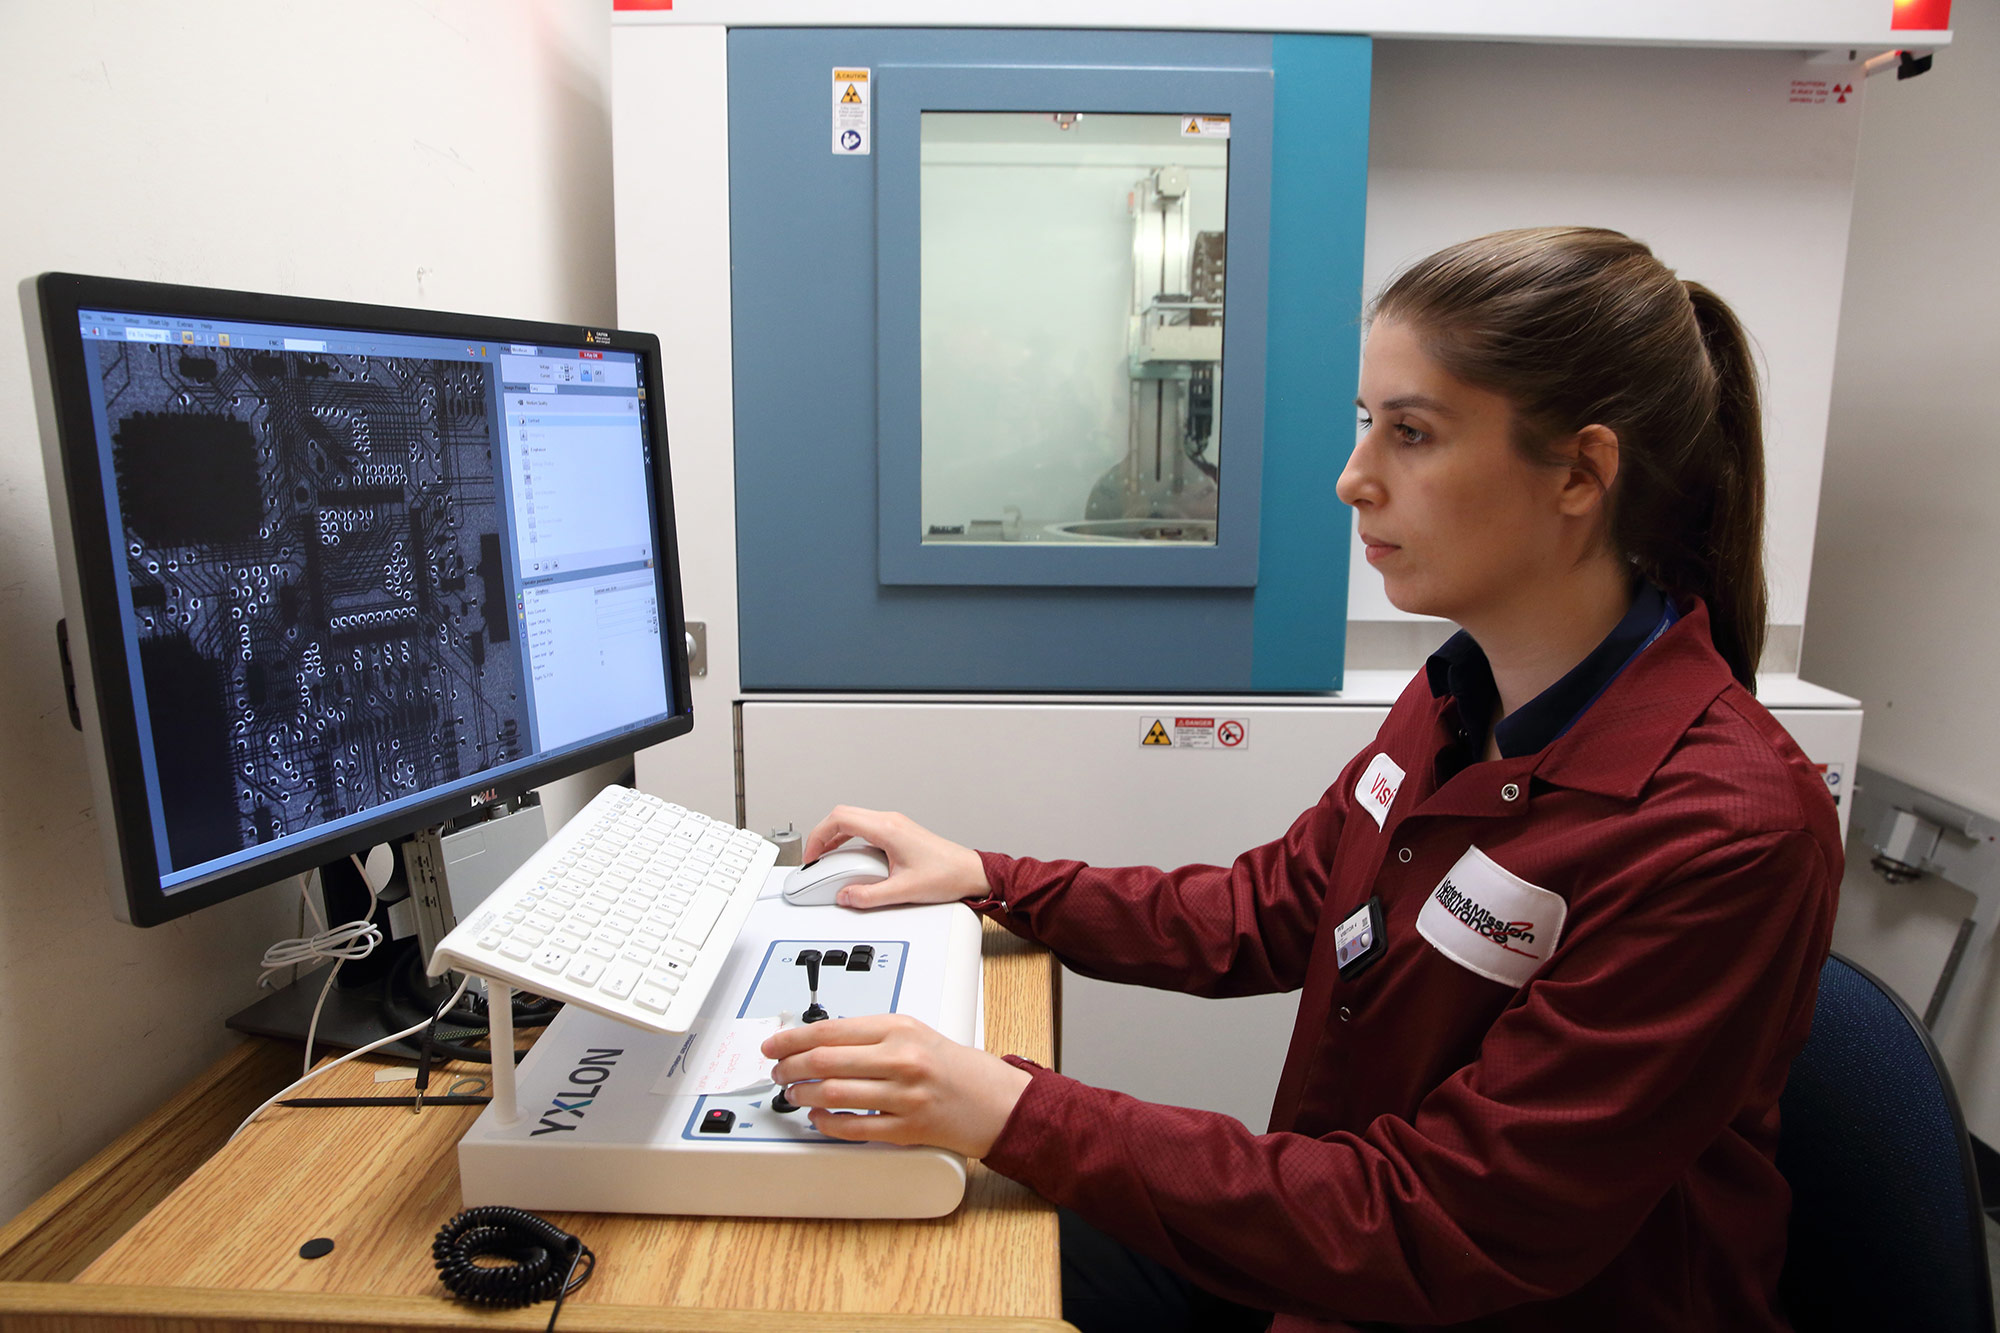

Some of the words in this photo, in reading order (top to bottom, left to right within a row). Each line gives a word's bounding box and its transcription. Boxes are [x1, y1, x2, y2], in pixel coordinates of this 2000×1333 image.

[471, 788, 498, 808] DELL
[1371, 771, 1397, 811] Visi
[1436, 889, 1509, 944] Assurance
[1463, 898, 1473, 911] &
[1469, 903, 1536, 944] Mission
[529, 1048, 625, 1137] YXLON
